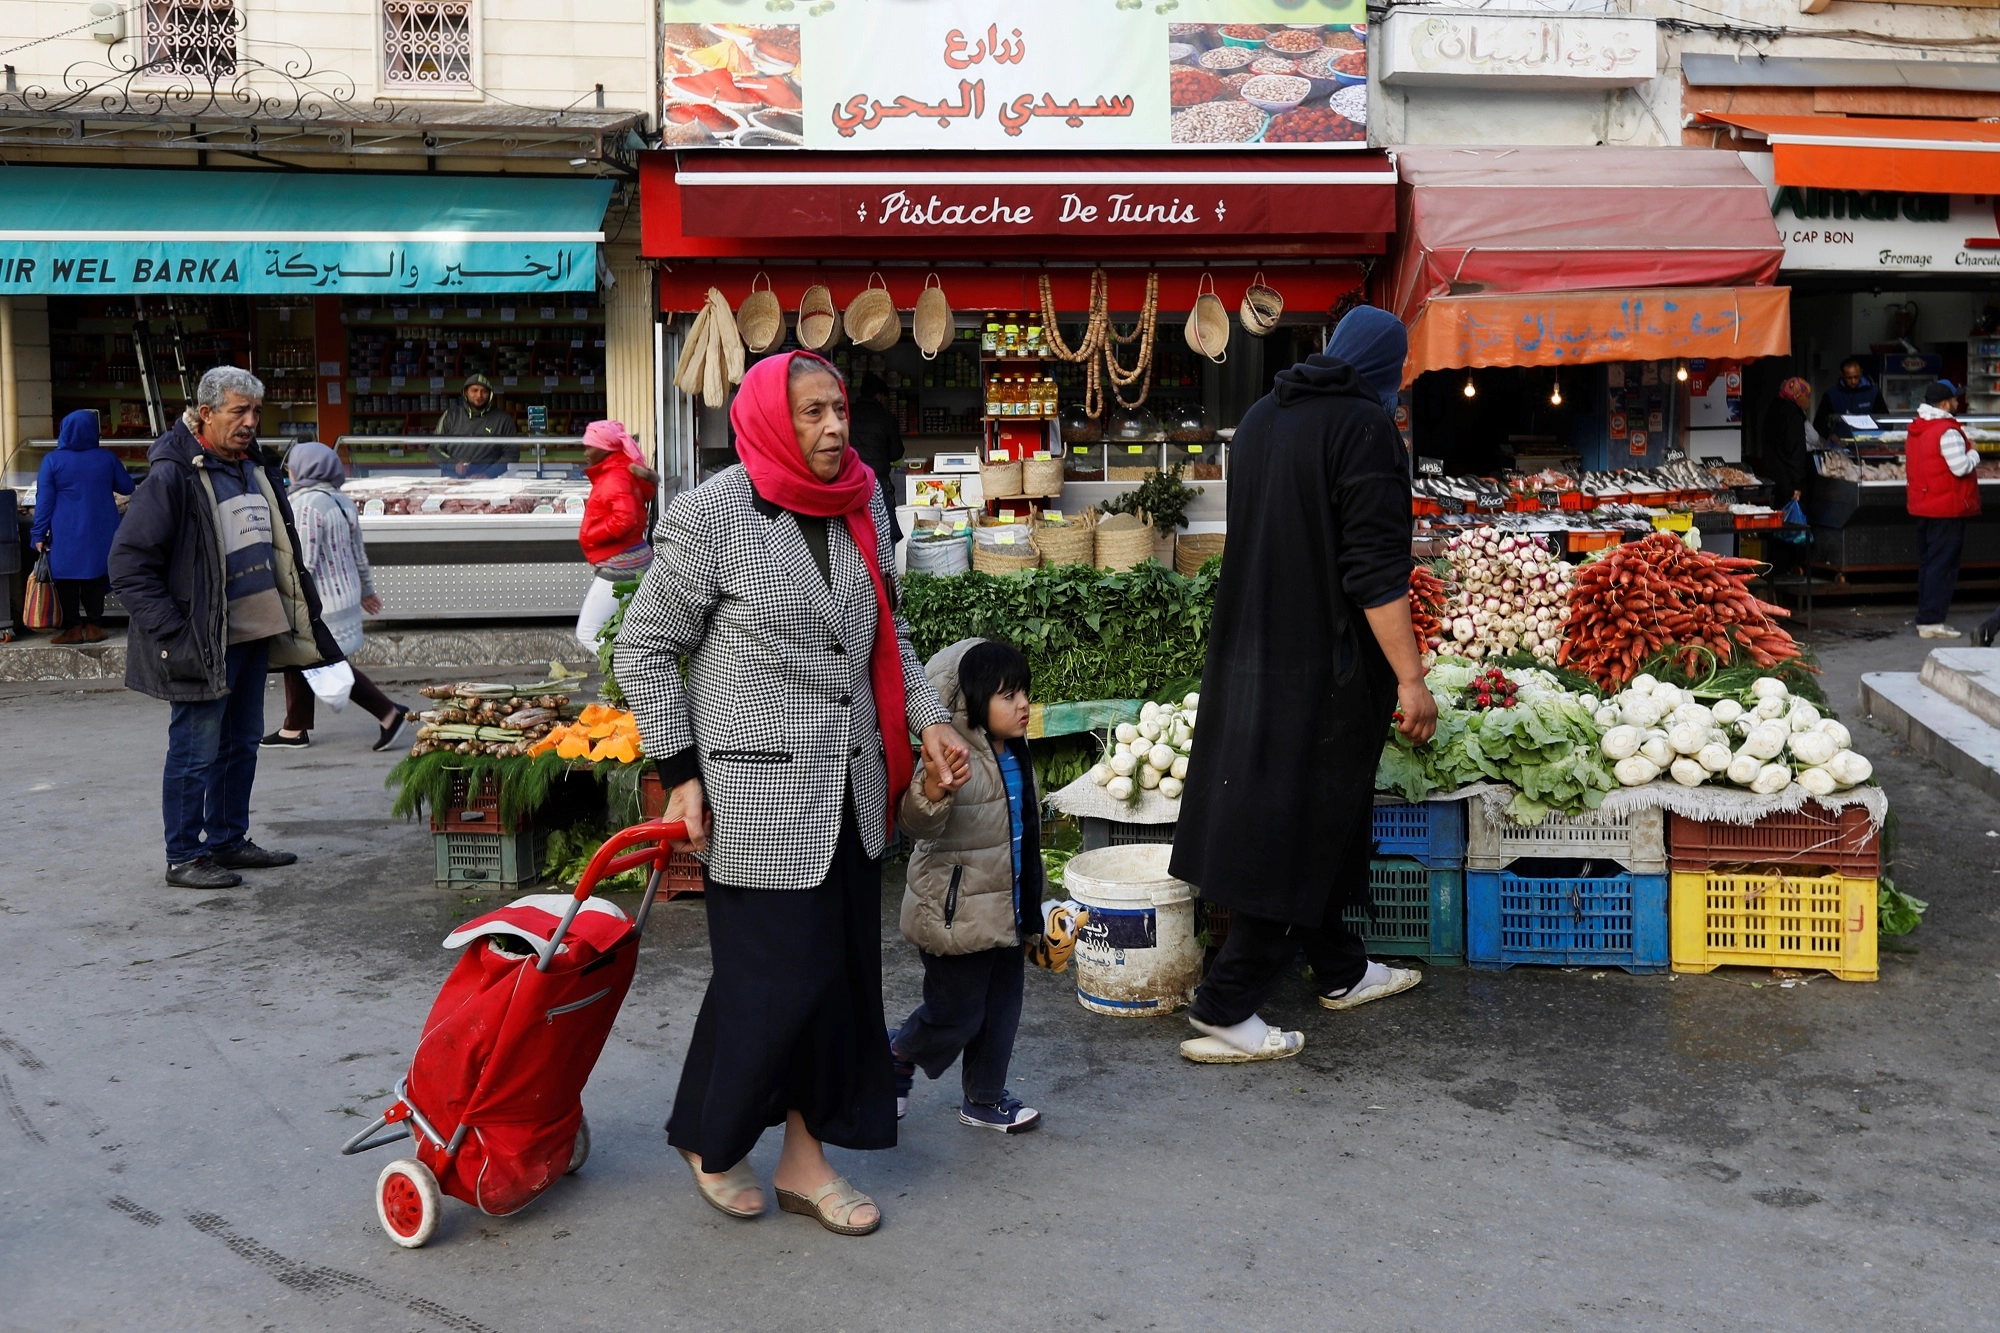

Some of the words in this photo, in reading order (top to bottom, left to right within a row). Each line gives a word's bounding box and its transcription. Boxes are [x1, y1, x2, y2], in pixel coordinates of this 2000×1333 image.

[943, 22, 1025, 70] زرارع
[831, 77, 985, 138] البحري
[998, 92, 1135, 137] سيدي
[879, 191, 1034, 226] Pistache
[1058, 192, 1097, 223] De
[1107, 192, 1200, 225] Tunis
[1793, 230, 1818, 243] CAP
[1824, 231, 1854, 244] BON
[52, 258, 117, 283] WEL
[132, 258, 240, 283] BARKA
[264, 249, 420, 288] والبركة
[434, 248, 573, 287] الخير
[1879, 249, 1932, 267] Fromage
[1439, 497, 1462, 510] 8980
[1480, 495, 1503, 507] 8600
